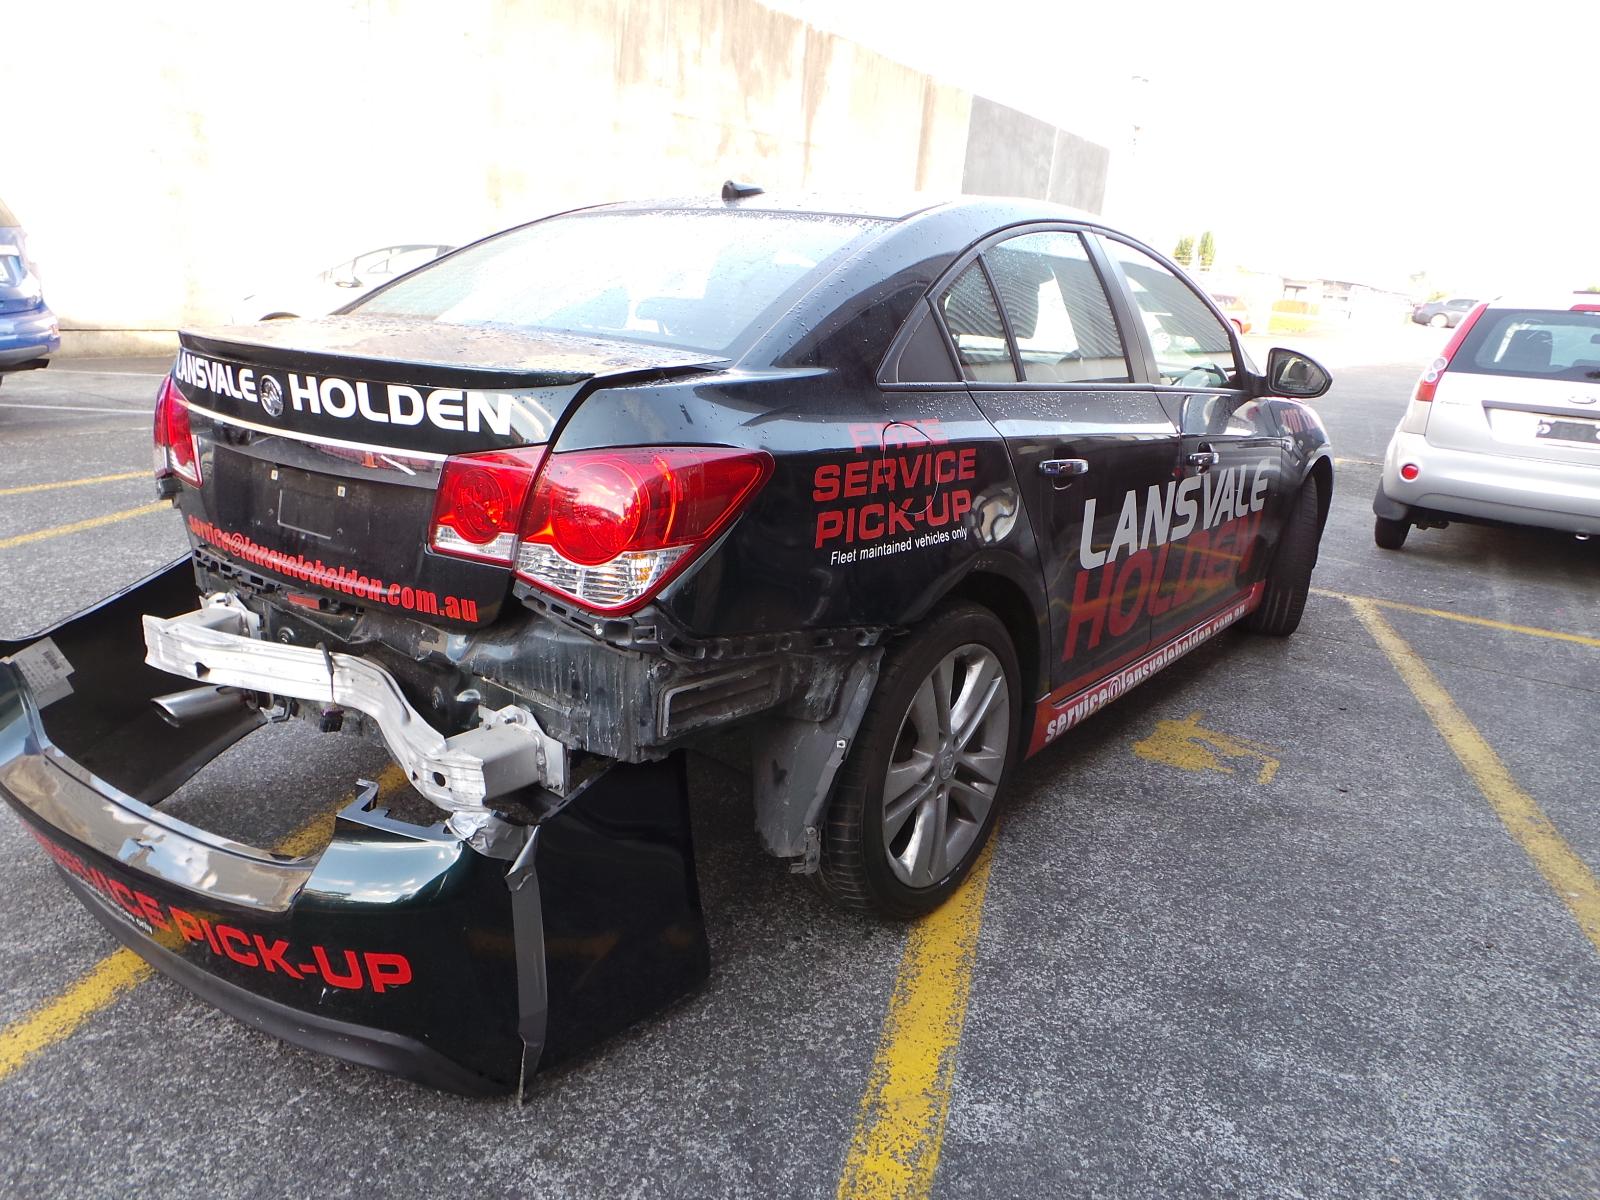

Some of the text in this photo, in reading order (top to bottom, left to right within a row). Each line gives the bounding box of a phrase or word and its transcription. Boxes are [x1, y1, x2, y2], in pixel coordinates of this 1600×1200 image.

[176, 351, 512, 436] LANSVALE HOLDEN
[848, 419, 948, 453] FREE
[812, 449, 976, 501] SERVICE
[1079, 458, 1270, 570] LANSVALE
[814, 490, 971, 548] PICK-UP
[830, 526, 967, 565] Fleet maintained vehicles only
[188, 514, 478, 622] service@lansvaleholden.com.au
[1062, 510, 1264, 662] HOLDEN
[1045, 604, 1245, 743] service@lansvaleholdencomau
[169, 907, 413, 993] PICK-UP
